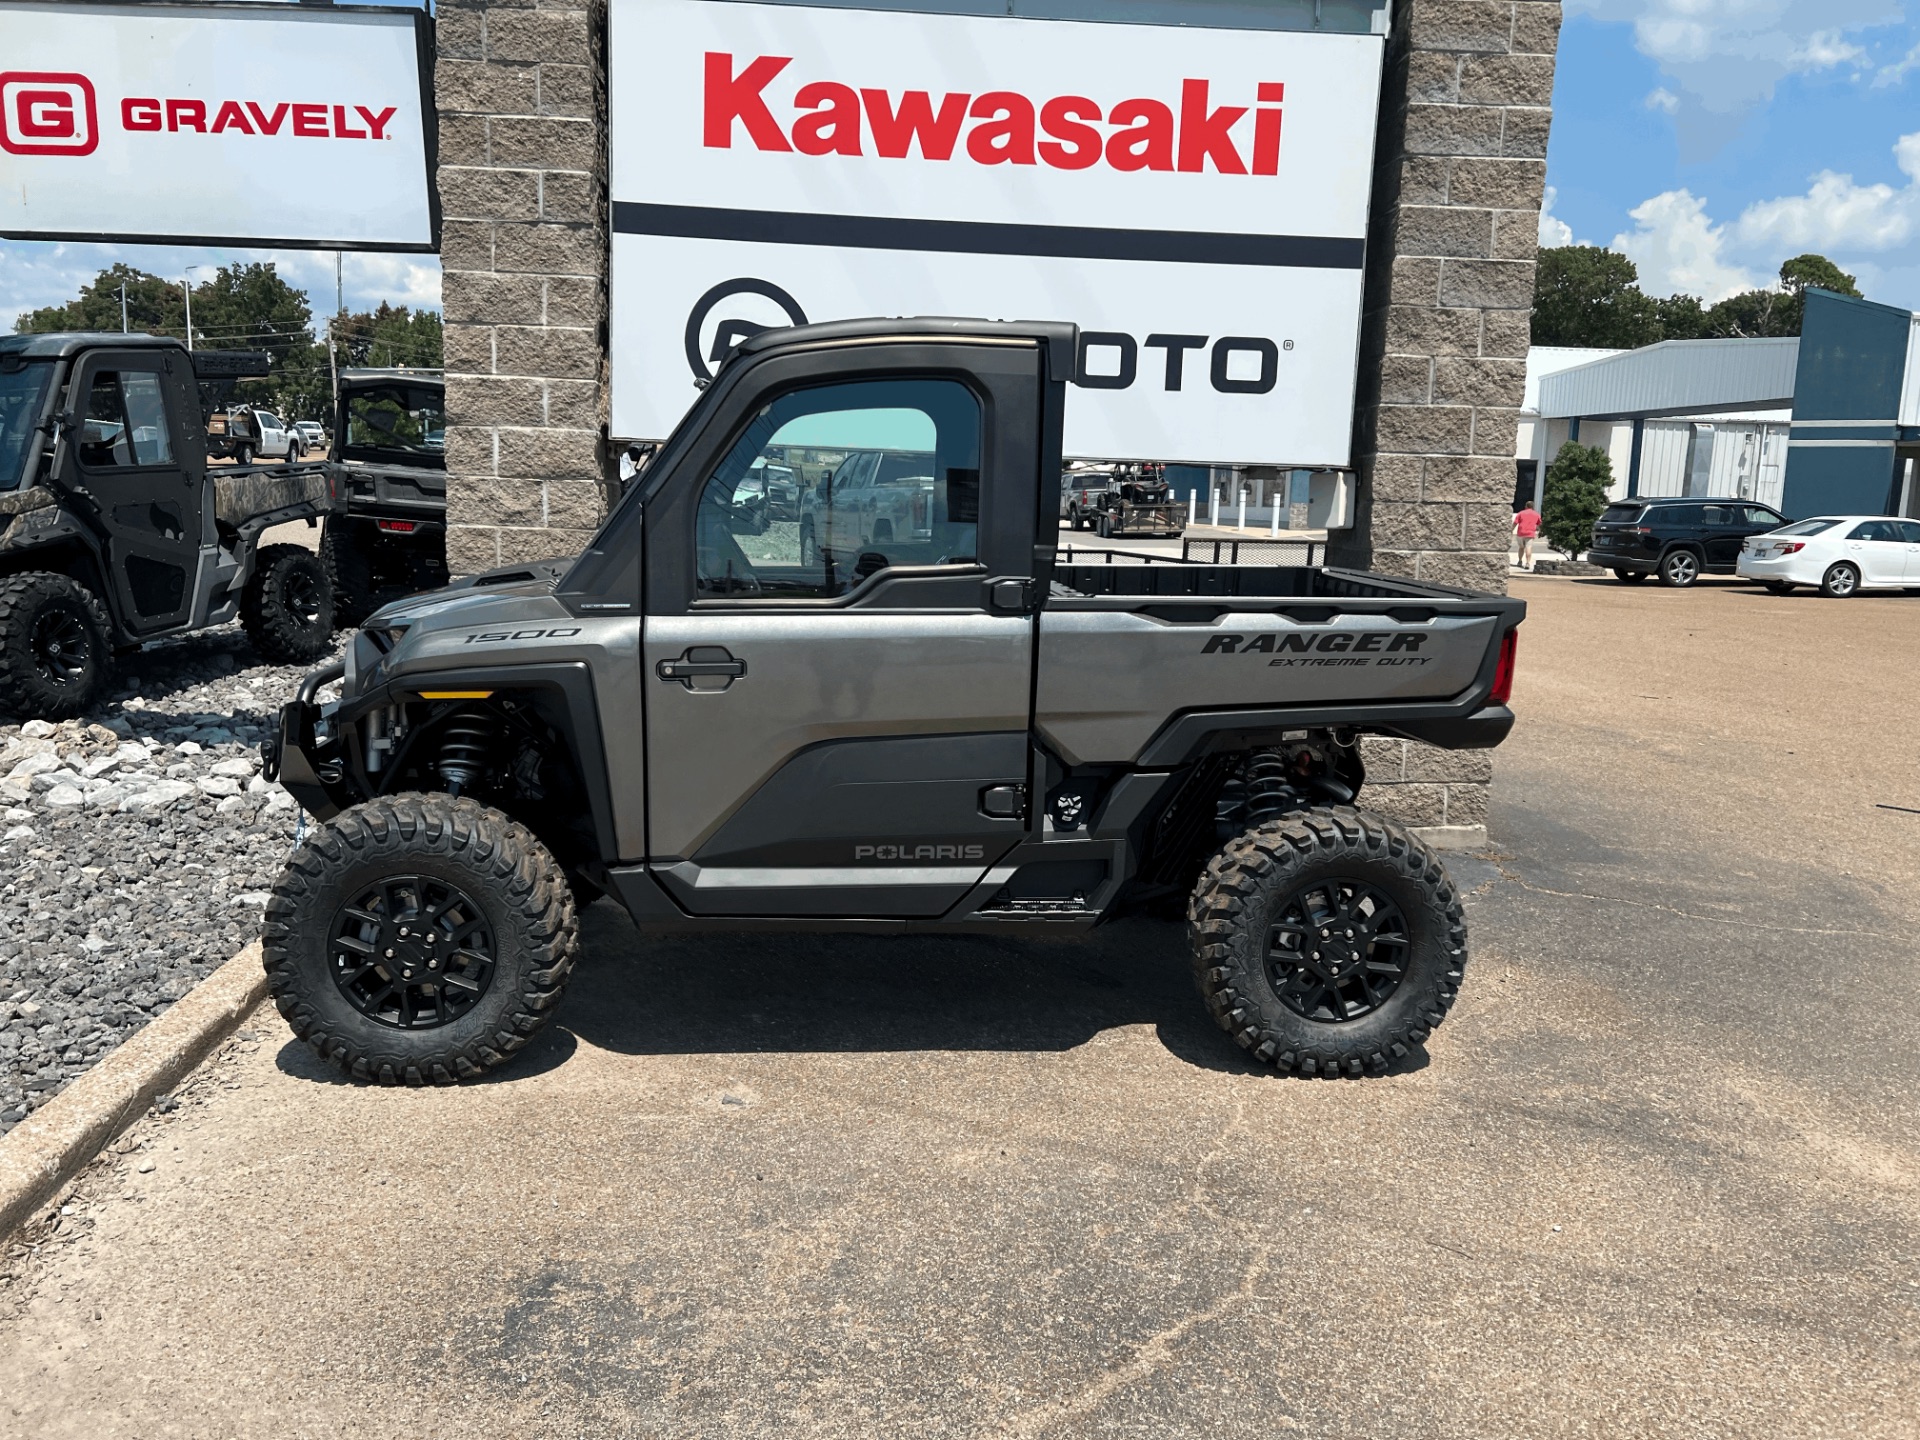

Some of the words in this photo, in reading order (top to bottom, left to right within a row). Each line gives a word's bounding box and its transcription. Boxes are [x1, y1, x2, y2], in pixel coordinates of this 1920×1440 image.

[120, 97, 397, 139] GRAVELY
[704, 52, 1284, 176] Kawasaki
[465, 628, 582, 644] 1500
[1200, 633, 1428, 653] RANGER
[1268, 658, 1371, 667] EXTREME
[1376, 657, 1433, 666] DUTY
[855, 845, 984, 859] POLARIS
